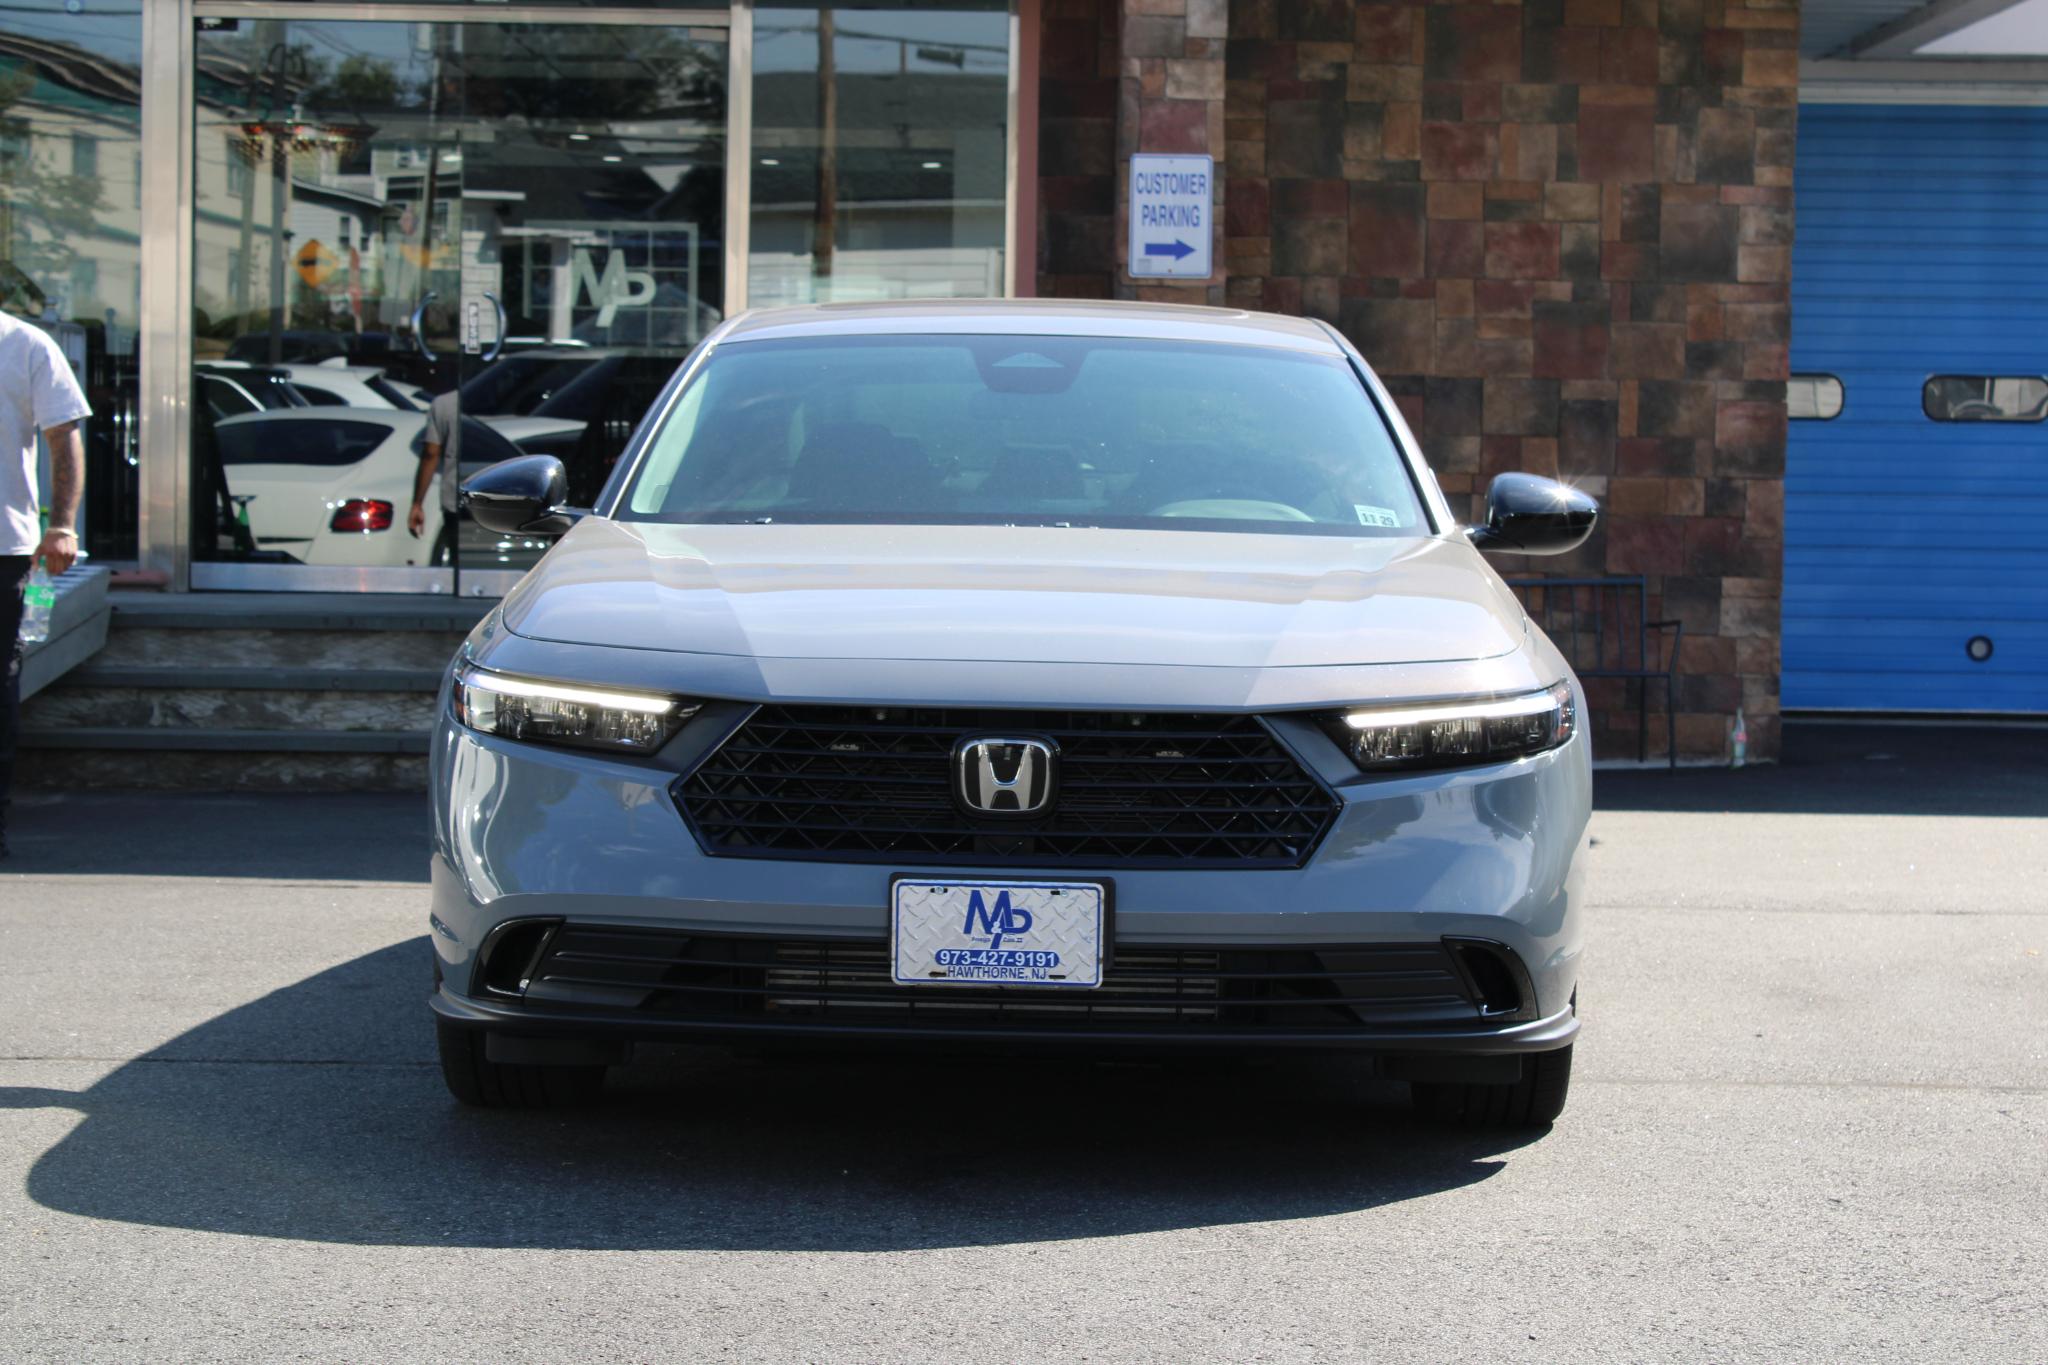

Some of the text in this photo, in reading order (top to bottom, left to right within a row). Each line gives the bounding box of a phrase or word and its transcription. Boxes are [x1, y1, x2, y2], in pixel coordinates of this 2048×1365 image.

[1136, 173, 1206, 195] CUSTOMER
[1142, 204, 1200, 227] PARKING
[939, 950, 1057, 967] 973-427-9191
[947, 966, 1047, 980] HAWTHORNE, NJ
